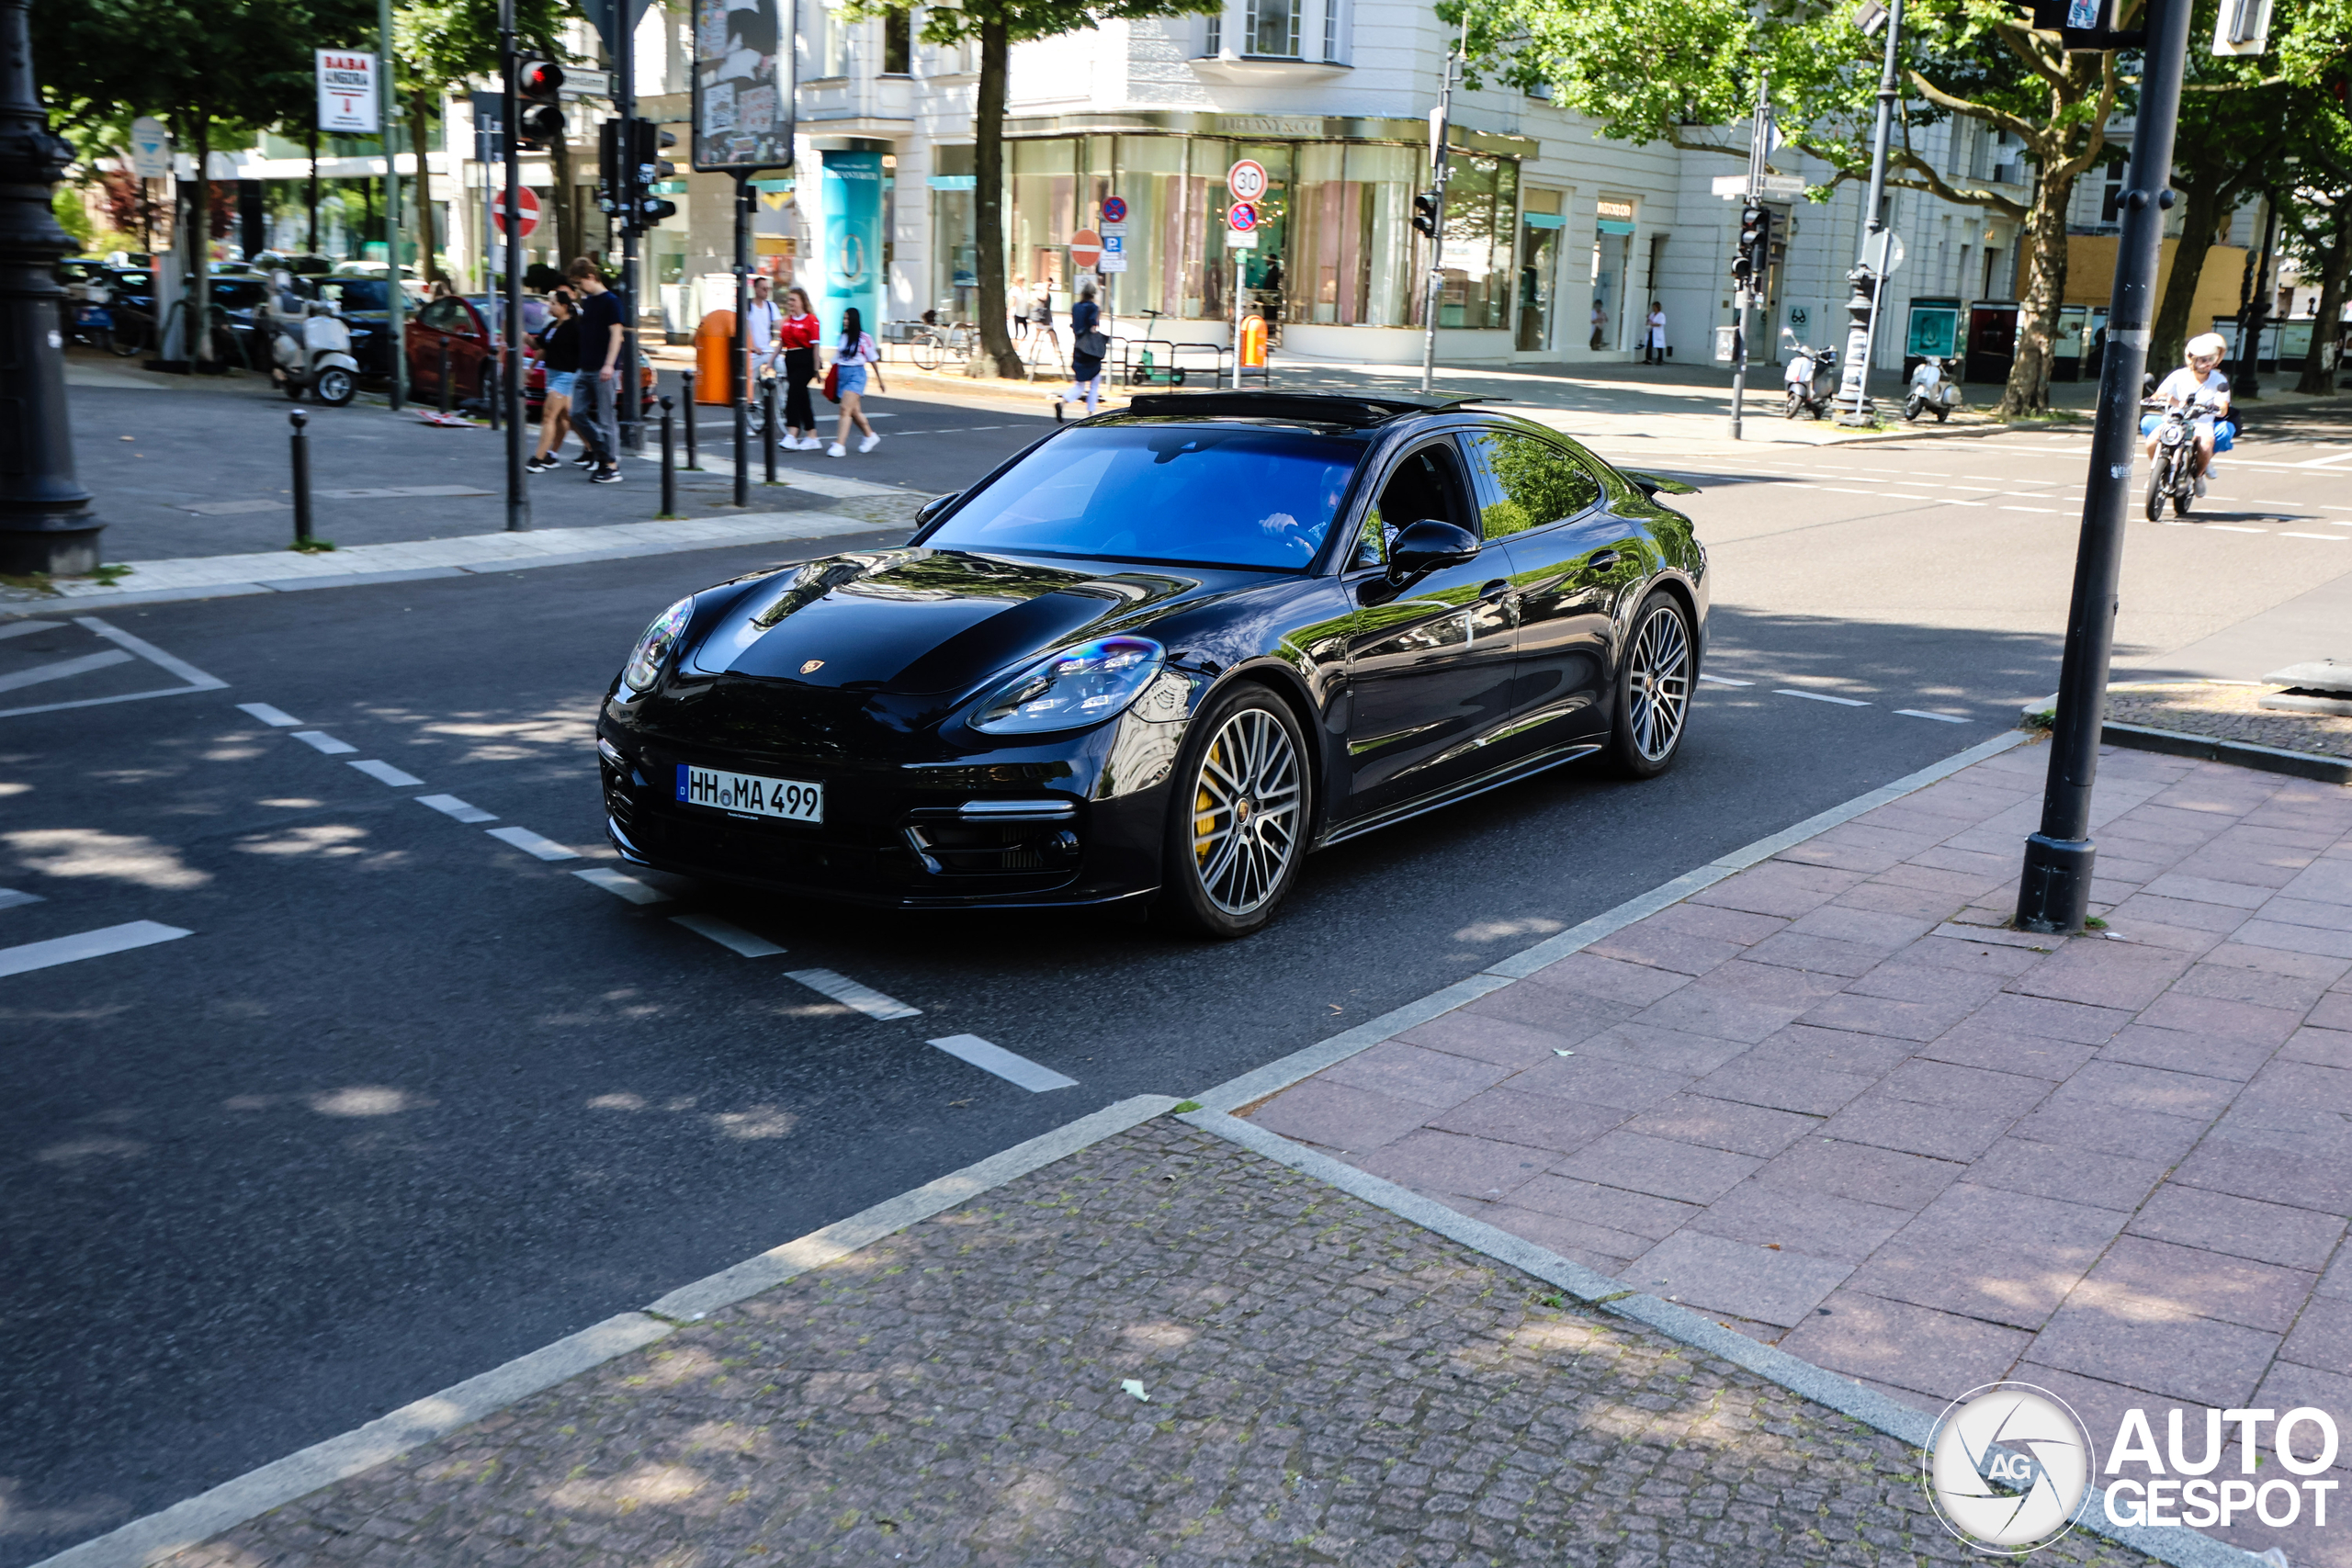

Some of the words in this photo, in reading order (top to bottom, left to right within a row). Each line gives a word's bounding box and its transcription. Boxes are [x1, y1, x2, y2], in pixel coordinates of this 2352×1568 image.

[325, 56, 368, 71] BABA
[1237, 172, 1259, 191] 30
[1106, 238, 1119, 251] P
[690, 770, 718, 804] HH
[734, 777, 764, 810] MA
[770, 784, 819, 817] 499
